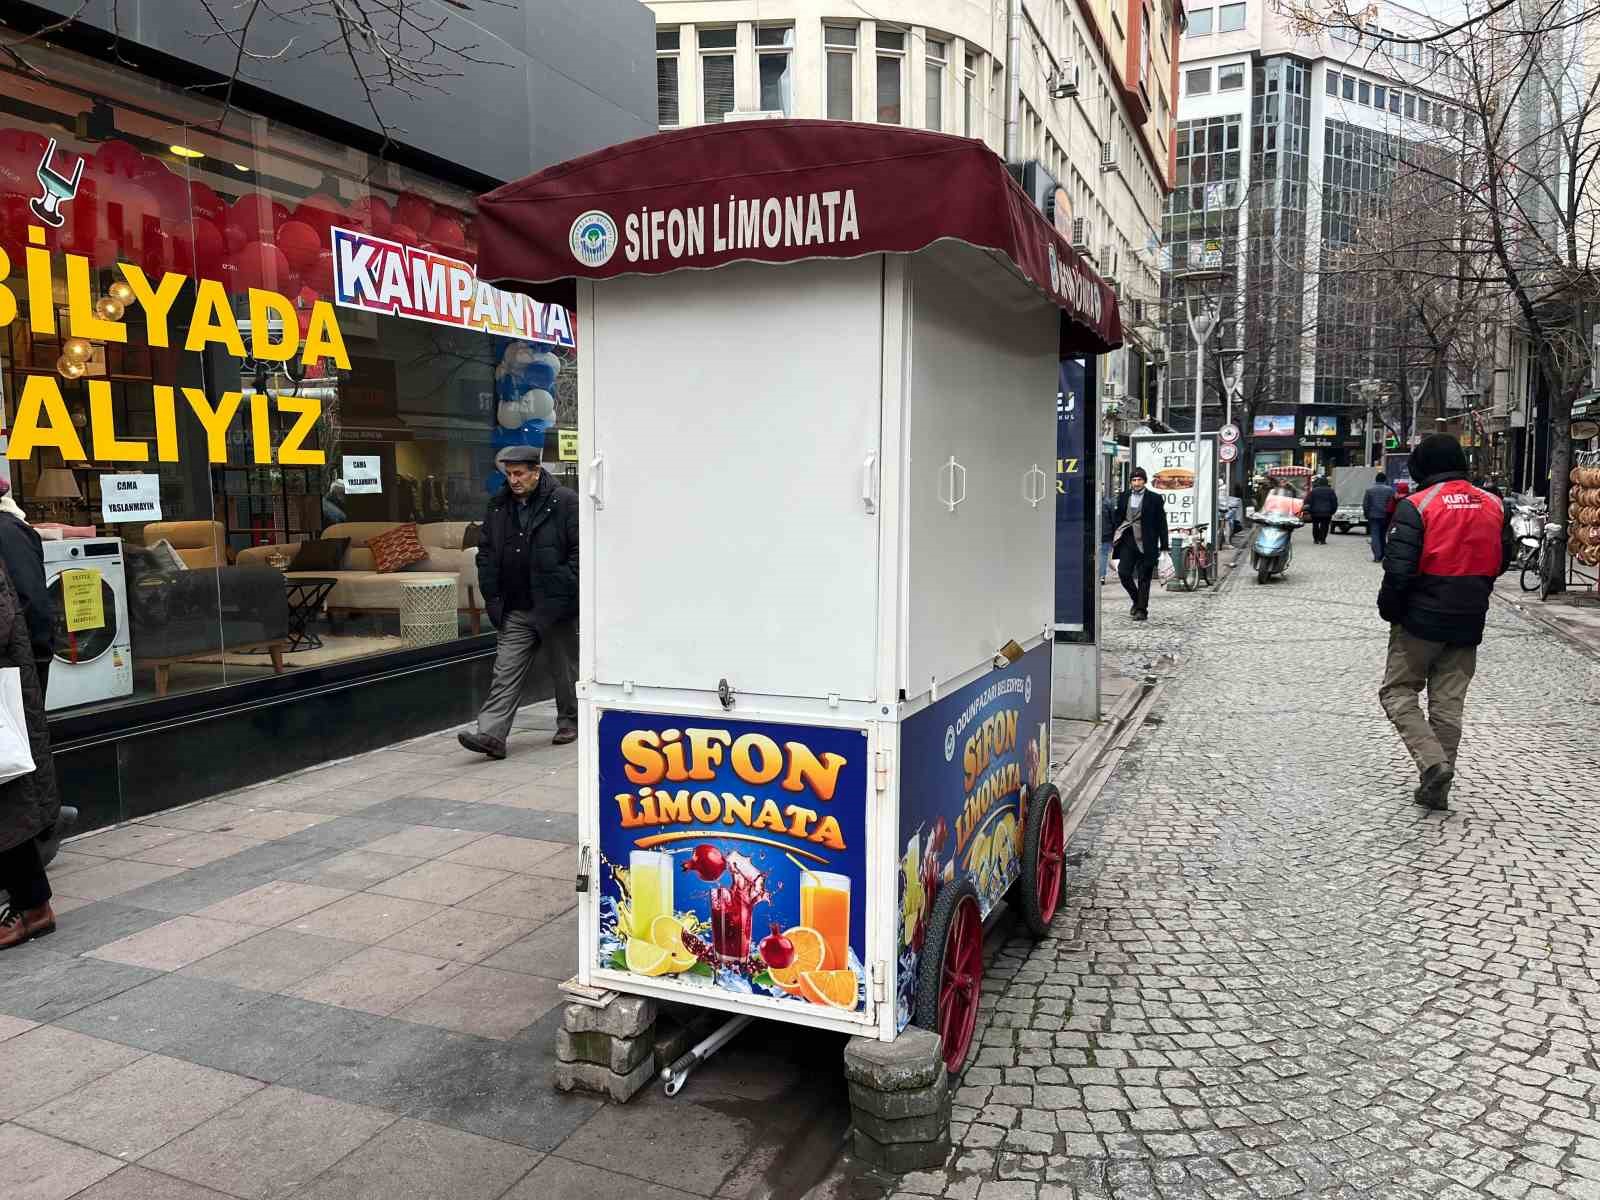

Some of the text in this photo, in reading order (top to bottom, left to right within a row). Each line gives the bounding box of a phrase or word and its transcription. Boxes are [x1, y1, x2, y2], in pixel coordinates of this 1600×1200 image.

[624, 205, 705, 262] SİFON
[713, 189, 860, 253] LİMONATA
[338, 236, 571, 339] KAMPANYA
[5, 374, 326, 465] ALIYIZ
[1163, 455, 1185, 468] ET
[108, 502, 155, 513] YASLANMAYIN
[116, 481, 138, 491] CAMA
